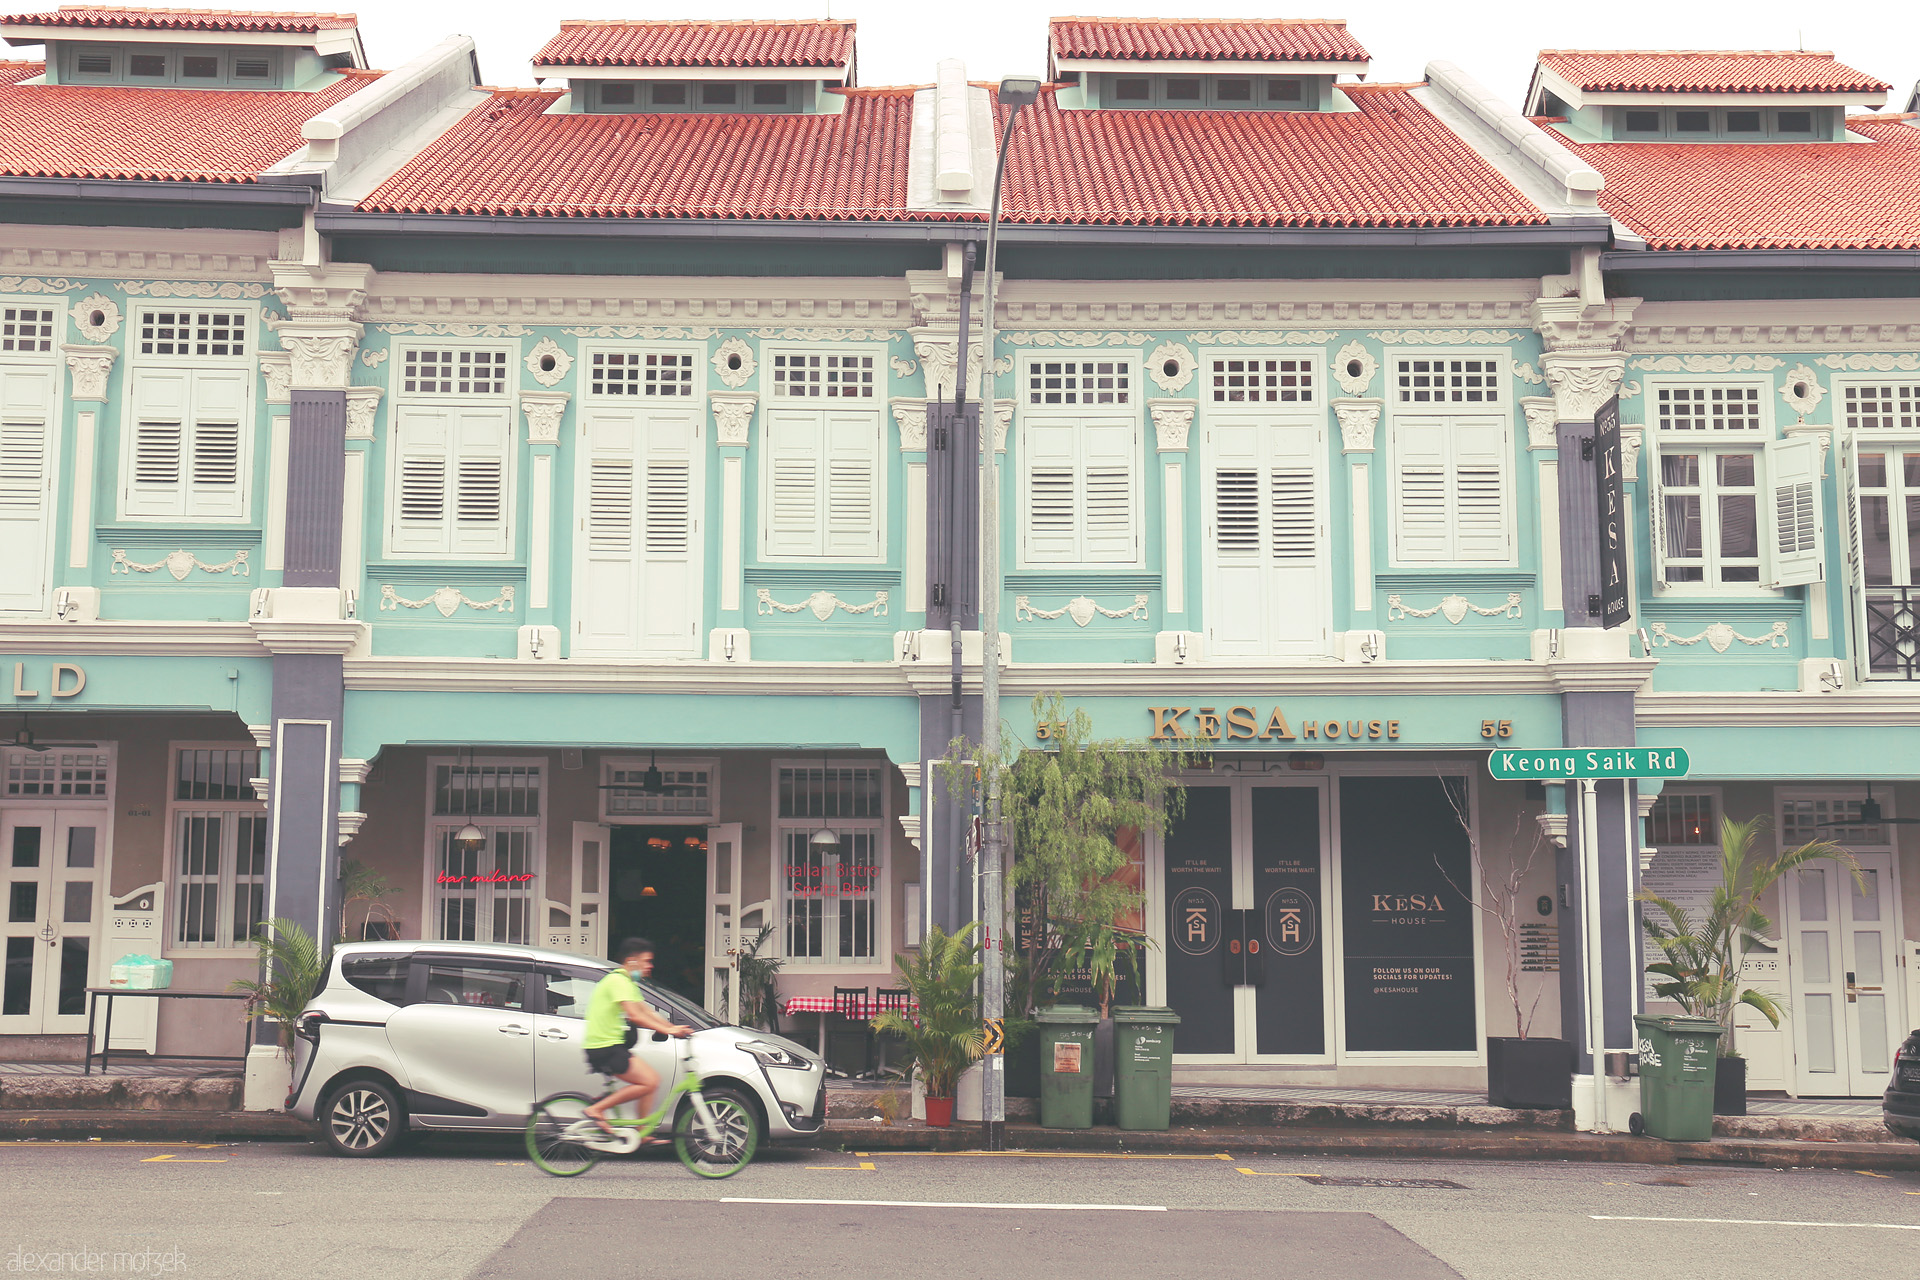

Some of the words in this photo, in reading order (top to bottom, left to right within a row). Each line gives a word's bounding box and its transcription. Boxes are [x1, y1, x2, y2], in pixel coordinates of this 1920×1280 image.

[1607, 596, 1625, 615] HOUSE
[1036, 721, 1066, 739] 55
[1303, 720, 1401, 739] HOUSE
[1481, 719, 1513, 738] 55
[1502, 752, 1576, 776] Keong
[1586, 751, 1637, 771] Saik
[1648, 751, 1676, 770] Rd
[437, 870, 468, 883] bar
[470, 869, 536, 883] milano
[783, 861, 831, 878] Italian
[835, 862, 880, 878] Bistro
[793, 882, 838, 900] Spritz
[843, 882, 869, 897] Bar
[1391, 917, 1427, 925] HOUSE
